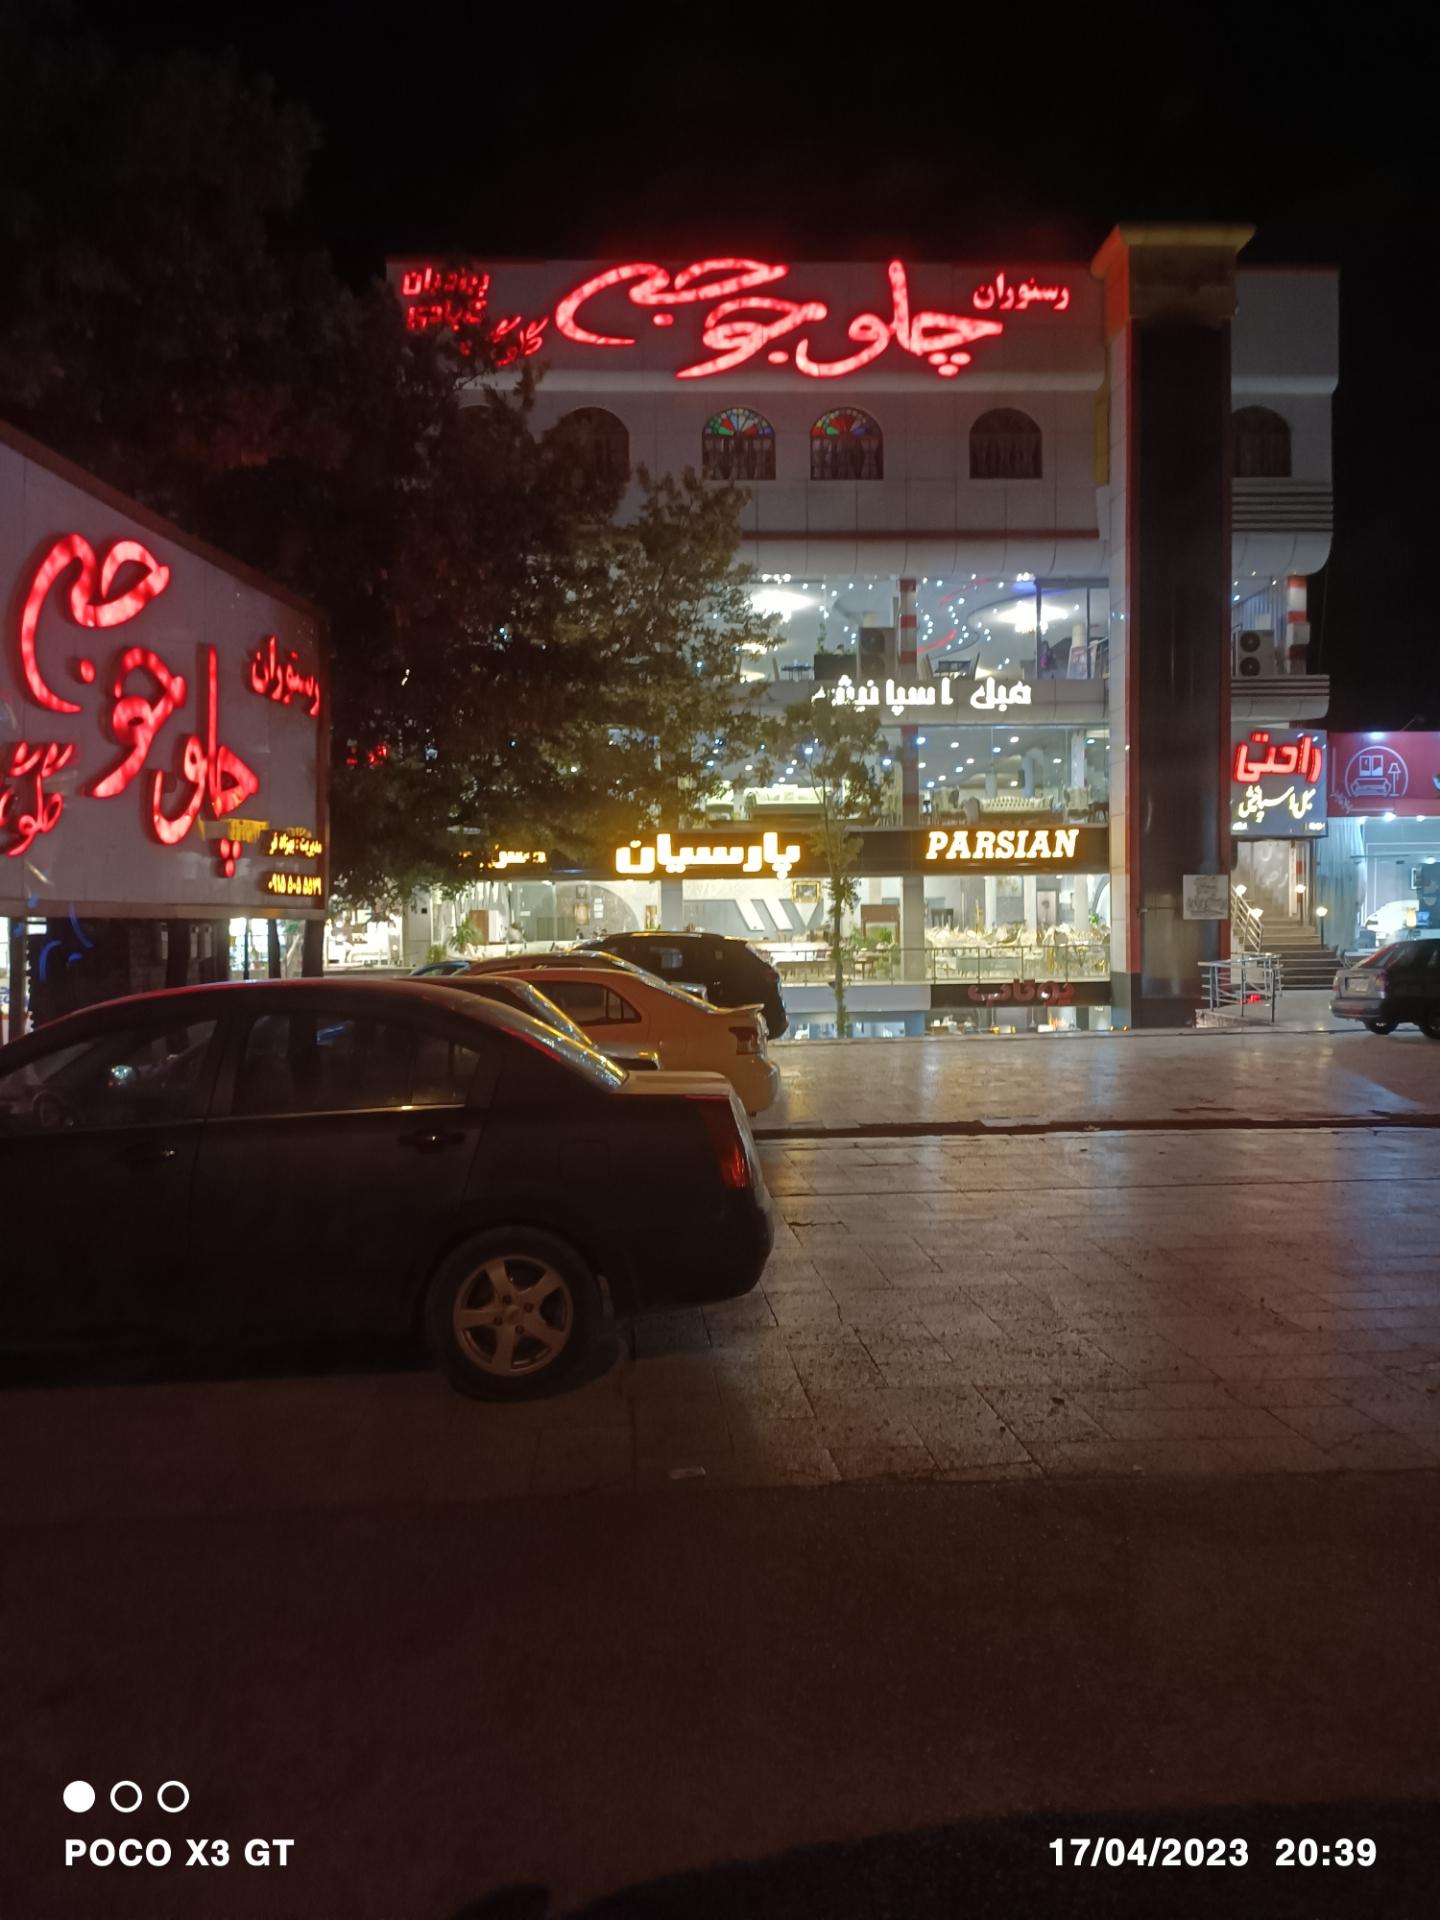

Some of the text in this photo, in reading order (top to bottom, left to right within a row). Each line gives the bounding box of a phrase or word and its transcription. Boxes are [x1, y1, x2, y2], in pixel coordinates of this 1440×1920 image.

[972, 272, 1071, 310] رستوران
[250, 635, 320, 717] رستوران
[969, 676, 1032, 712] مبل
[1232, 731, 1322, 784] راحتی
[614, 831, 802, 879] پارسیان
[925, 829, 1079, 862] PARSIAN
